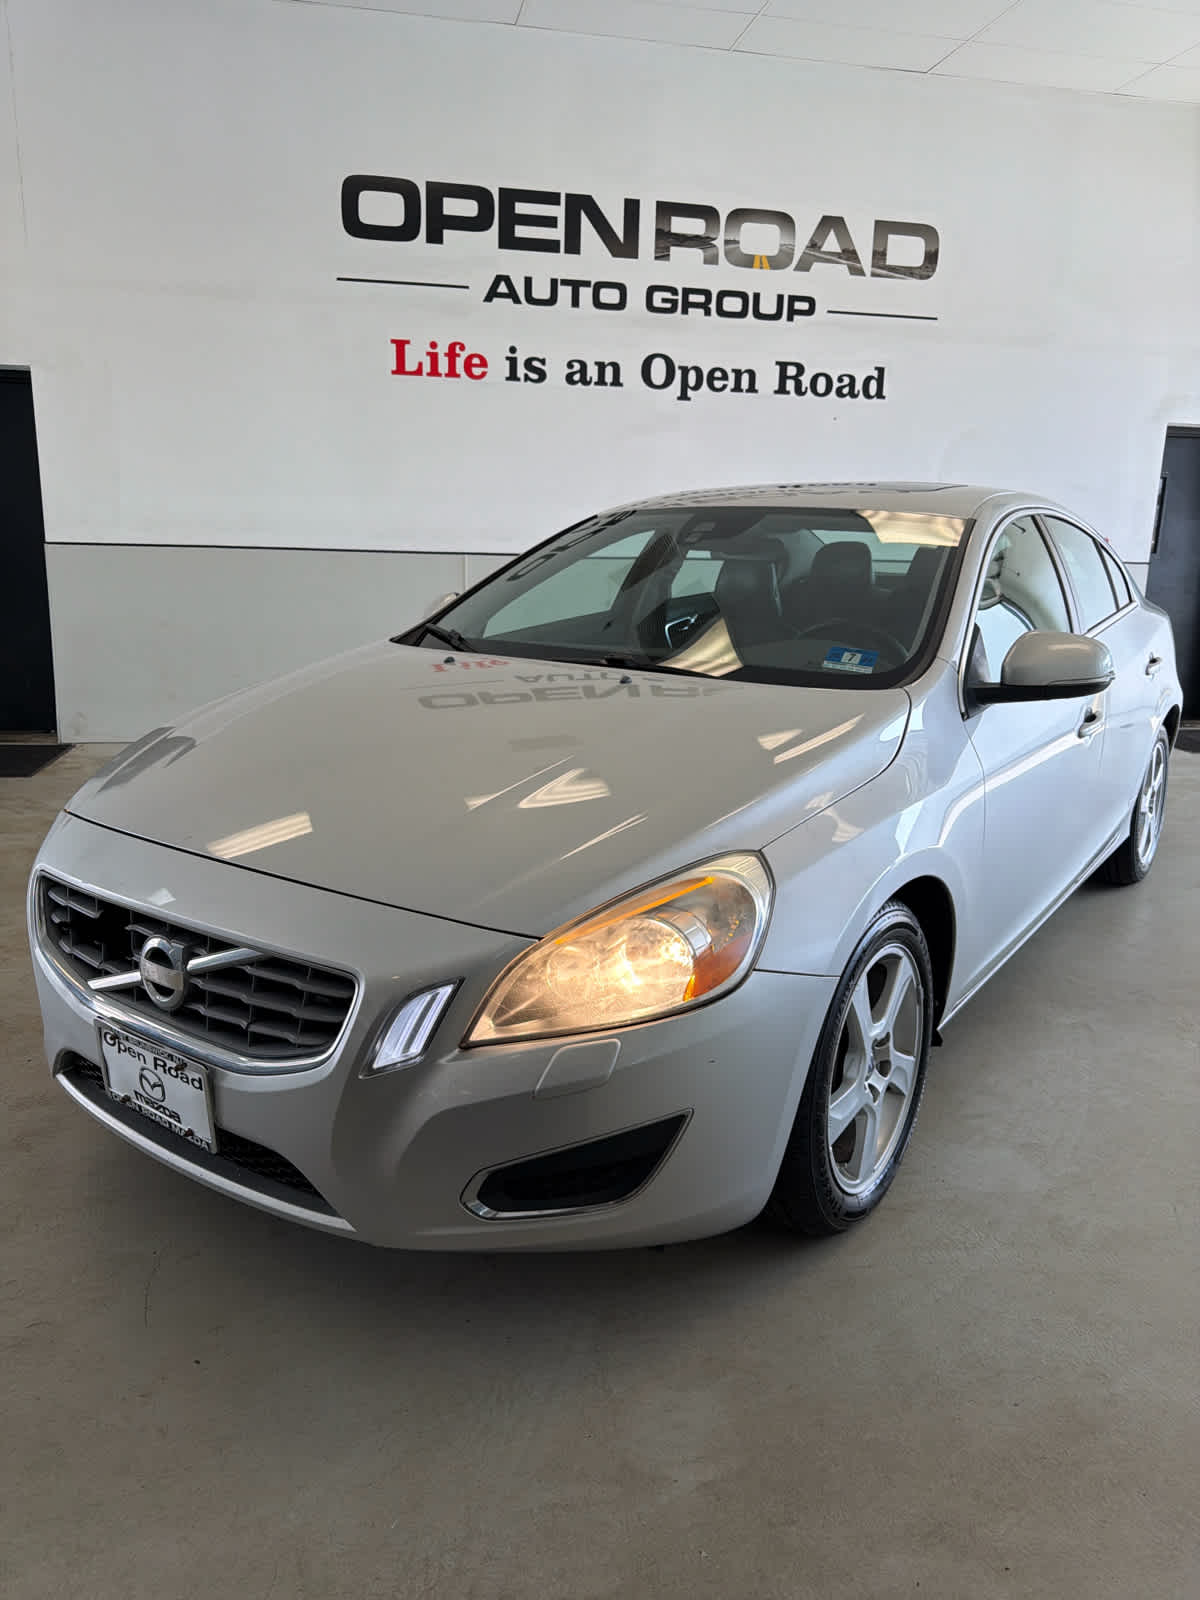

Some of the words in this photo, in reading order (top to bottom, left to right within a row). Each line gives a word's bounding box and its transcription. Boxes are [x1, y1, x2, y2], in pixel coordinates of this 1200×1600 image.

[341, 174, 640, 260] OPEN
[654, 200, 940, 280] ROAD
[483, 274, 628, 312] AUTO
[645, 284, 817, 323] GROUP
[390, 338, 489, 380] Life
[505, 345, 548, 384] is
[565, 360, 624, 388] an
[641, 352, 759, 402] Open
[774, 360, 887, 400] Road
[103, 1031, 147, 1065] Open
[153, 1056, 203, 1091] Road
